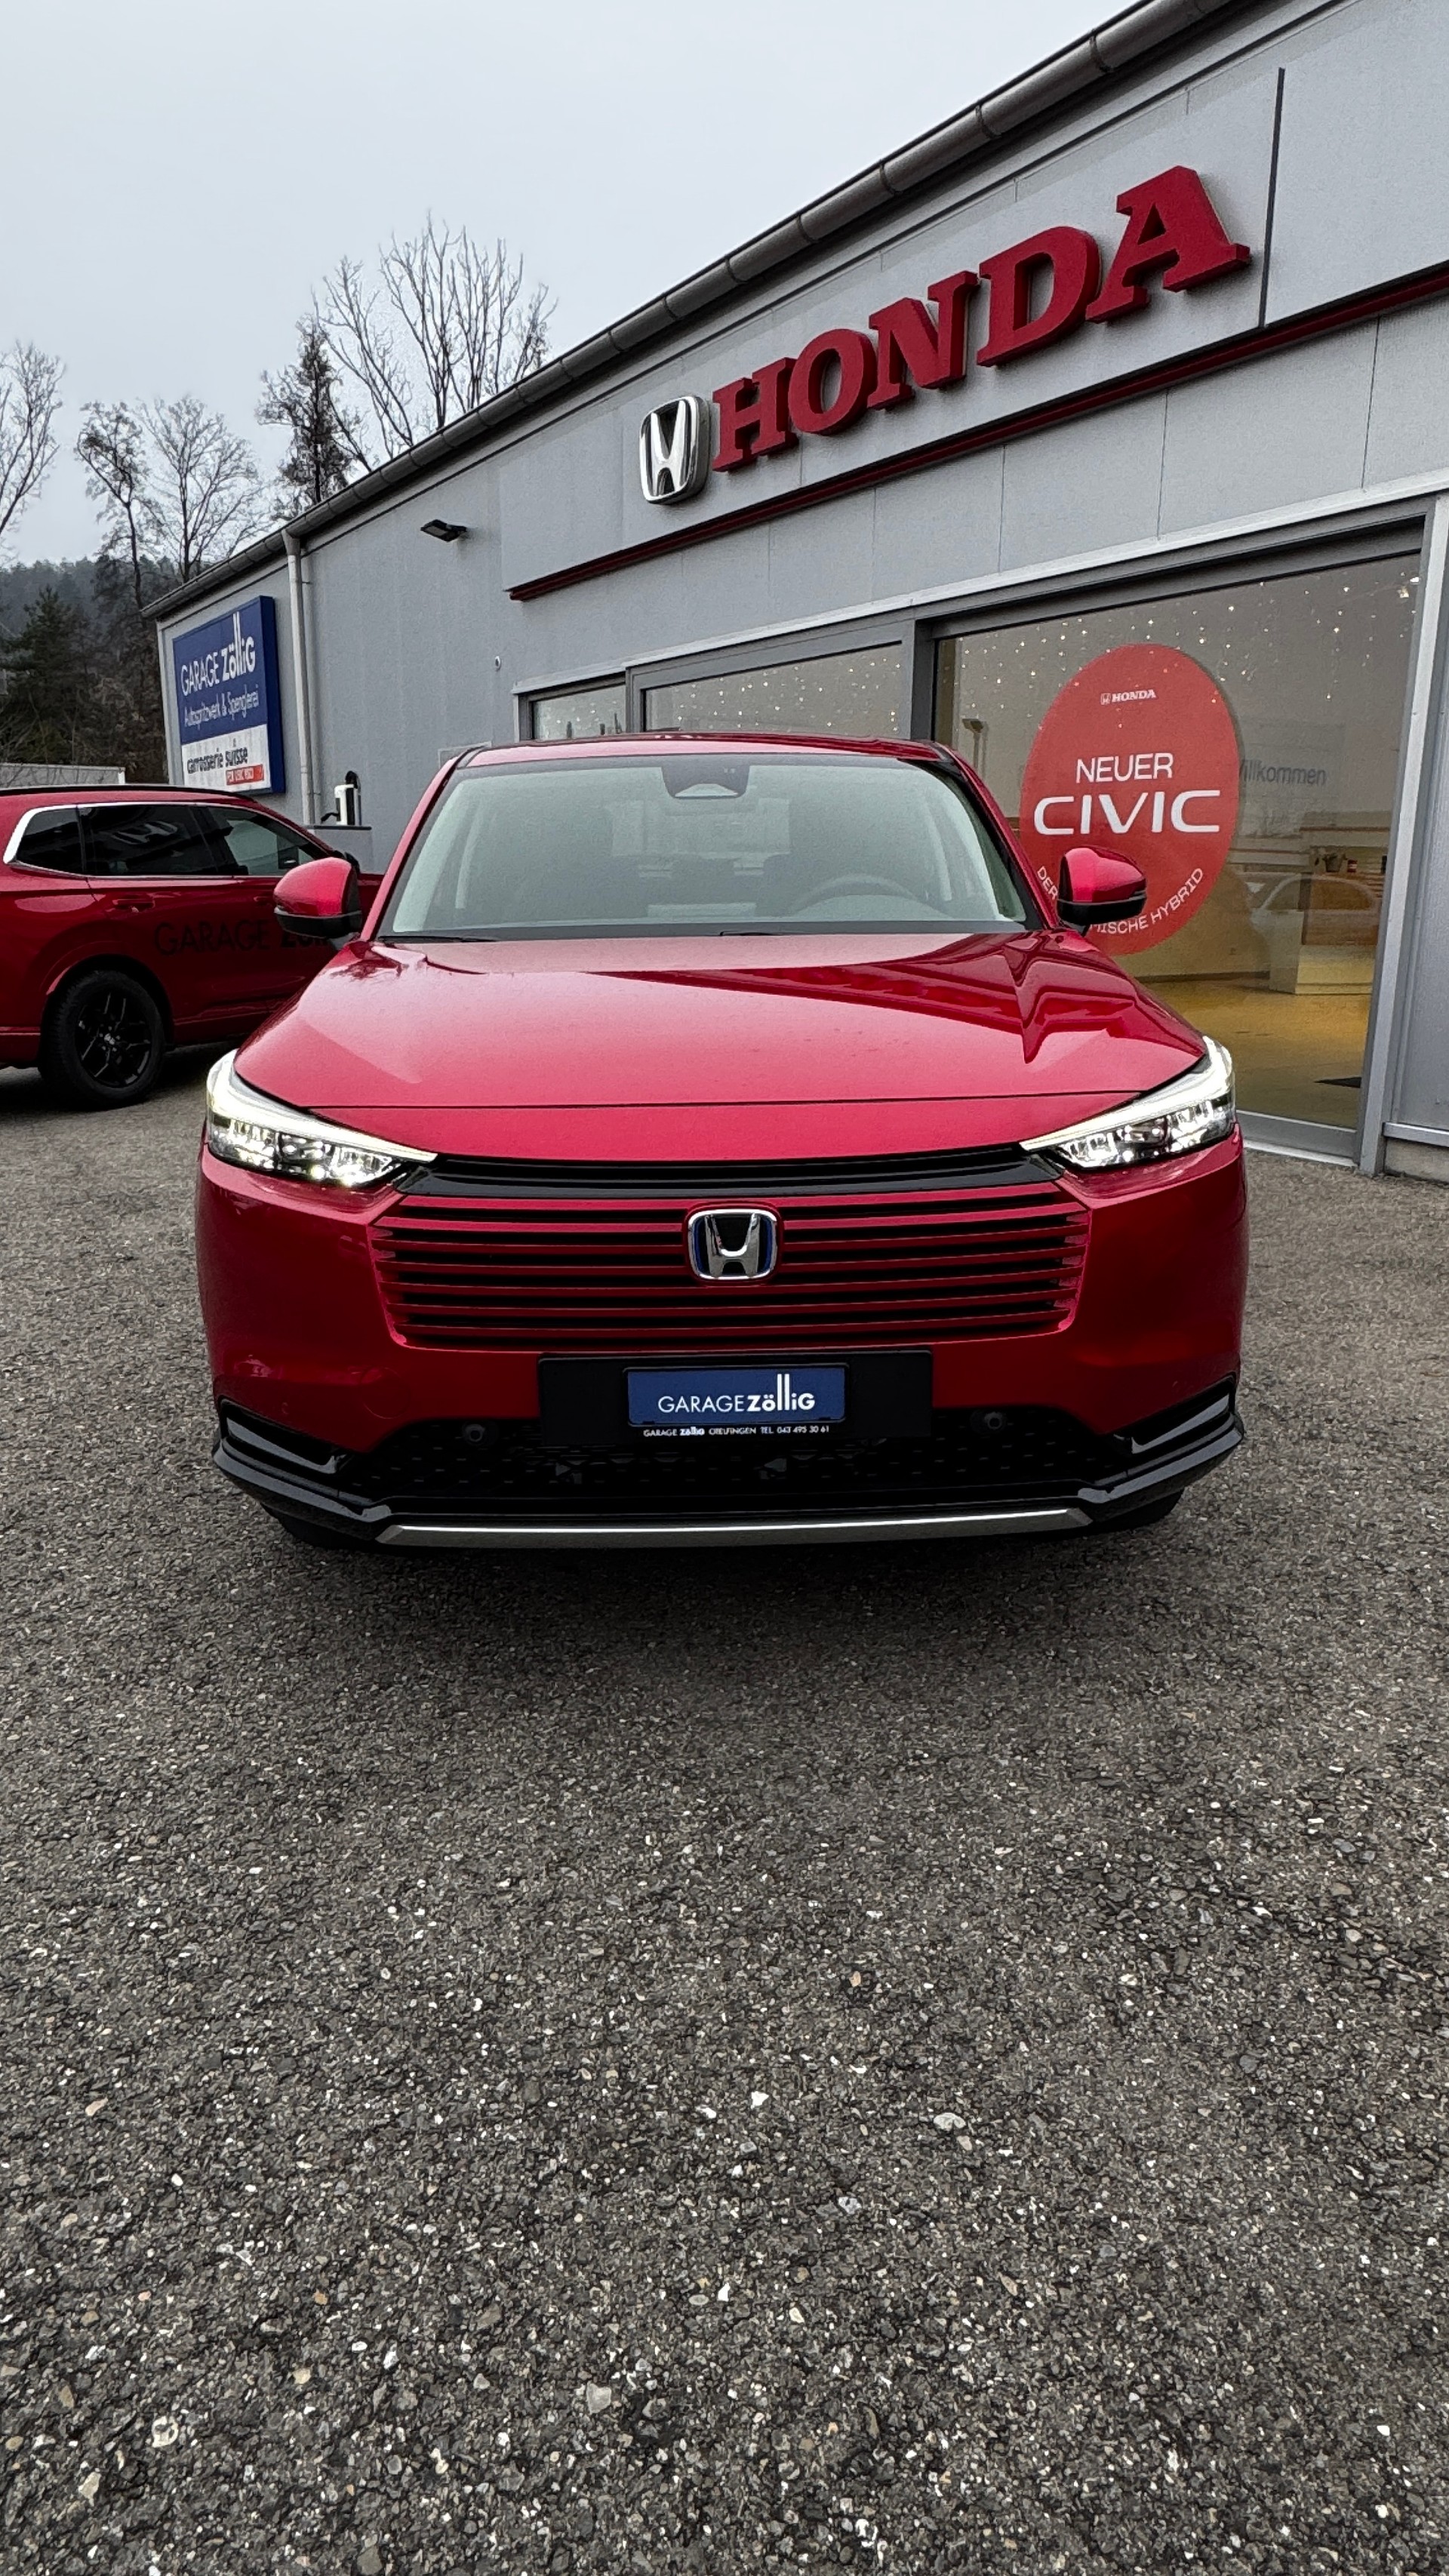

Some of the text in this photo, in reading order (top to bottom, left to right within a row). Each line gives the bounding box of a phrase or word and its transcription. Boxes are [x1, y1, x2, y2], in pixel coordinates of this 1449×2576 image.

[712, 165, 1251, 472] HONDA
[181, 652, 219, 695] GARAGE
[1112, 688, 1156, 703] HONDA
[1076, 752, 1174, 783] NEUER
[1033, 789, 1220, 836] CIVIC
[1037, 866, 1058, 900] DER
[1151, 868, 1204, 923] HYBRID
[155, 919, 269, 954] GARAGE
[658, 1396, 745, 1413] GARAGE
[643, 1429, 678, 1437] GARAGE
